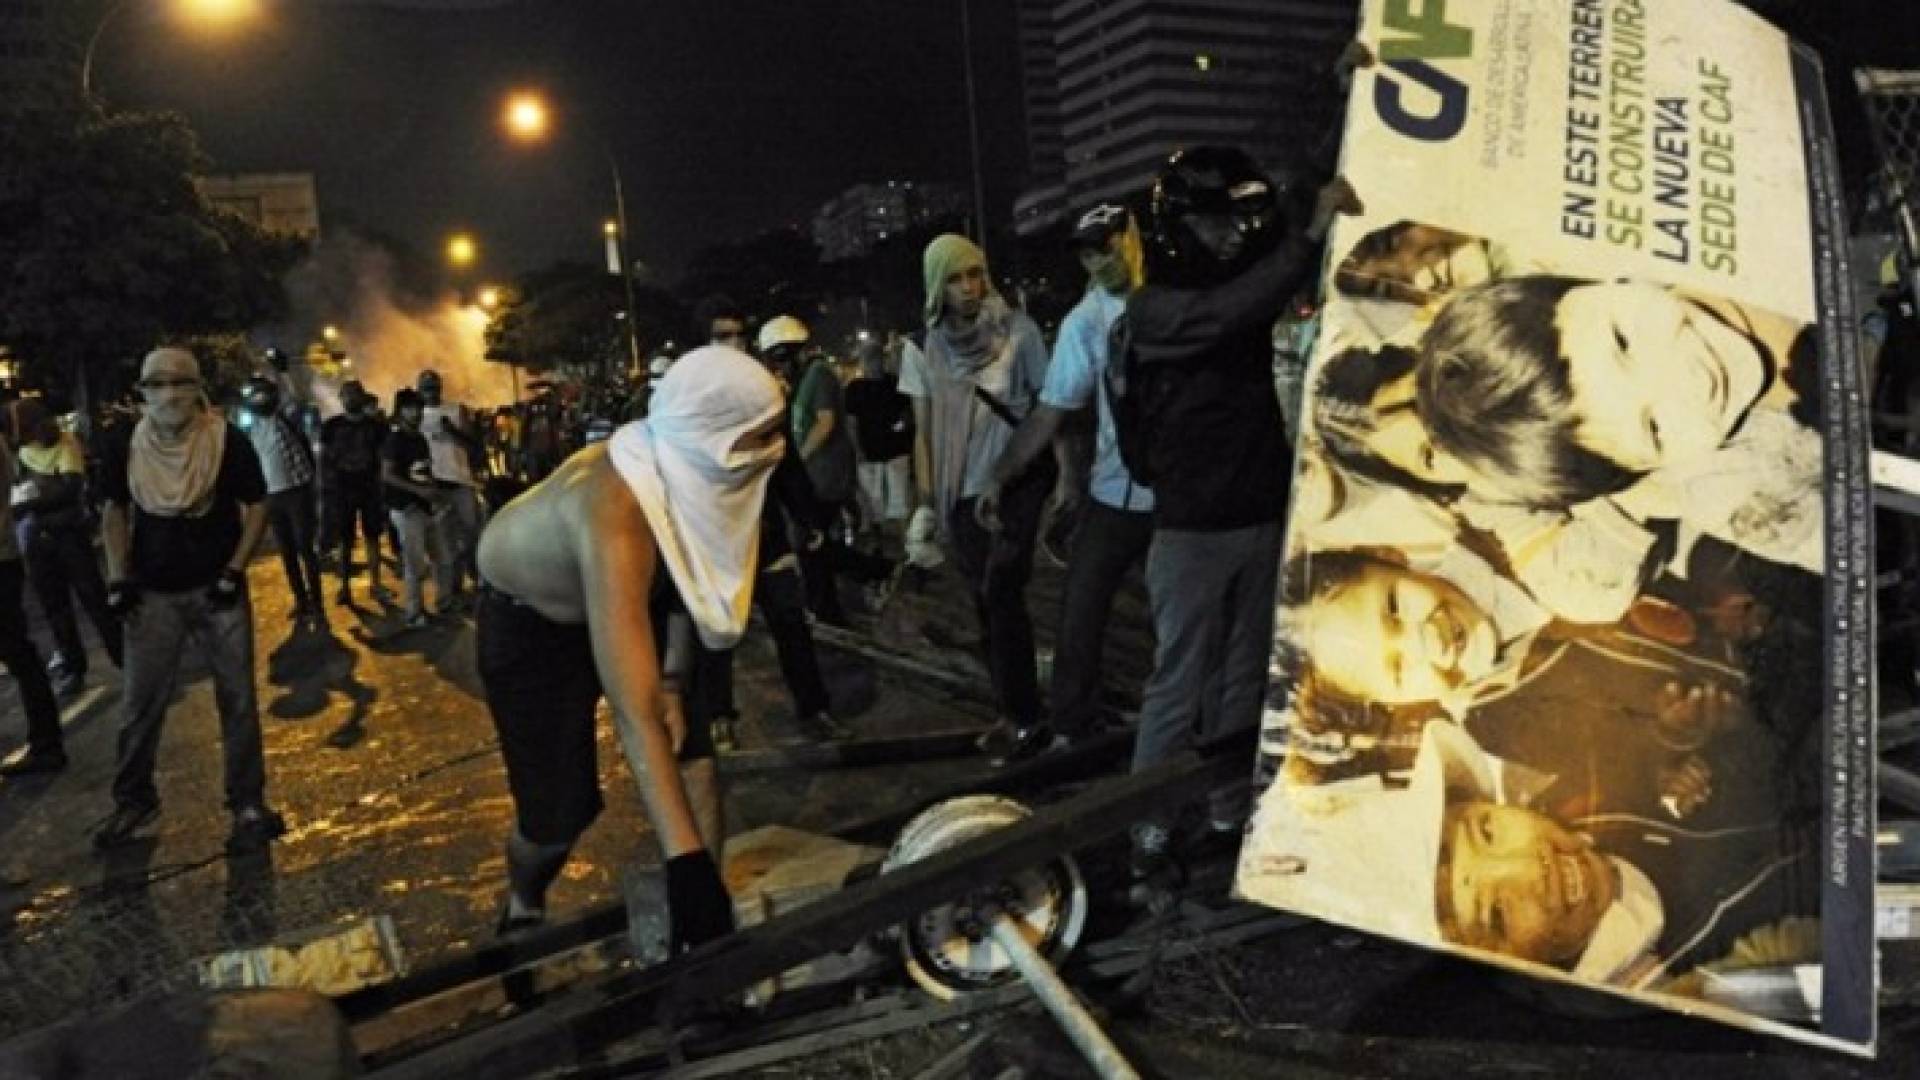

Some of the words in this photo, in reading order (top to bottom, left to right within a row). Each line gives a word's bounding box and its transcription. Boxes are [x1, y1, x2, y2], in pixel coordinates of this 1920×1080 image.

[1697, 57, 1733, 124] CAF
[1564, 107, 1600, 187] ESTE
[1652, 97, 1689, 208] NUEVA
[1699, 127, 1735, 175] DE
[1562, 192, 1597, 239] EN
[1606, 200, 1644, 249] SE
[1652, 219, 1689, 264] LA
[1700, 179, 1737, 276] SEDE
